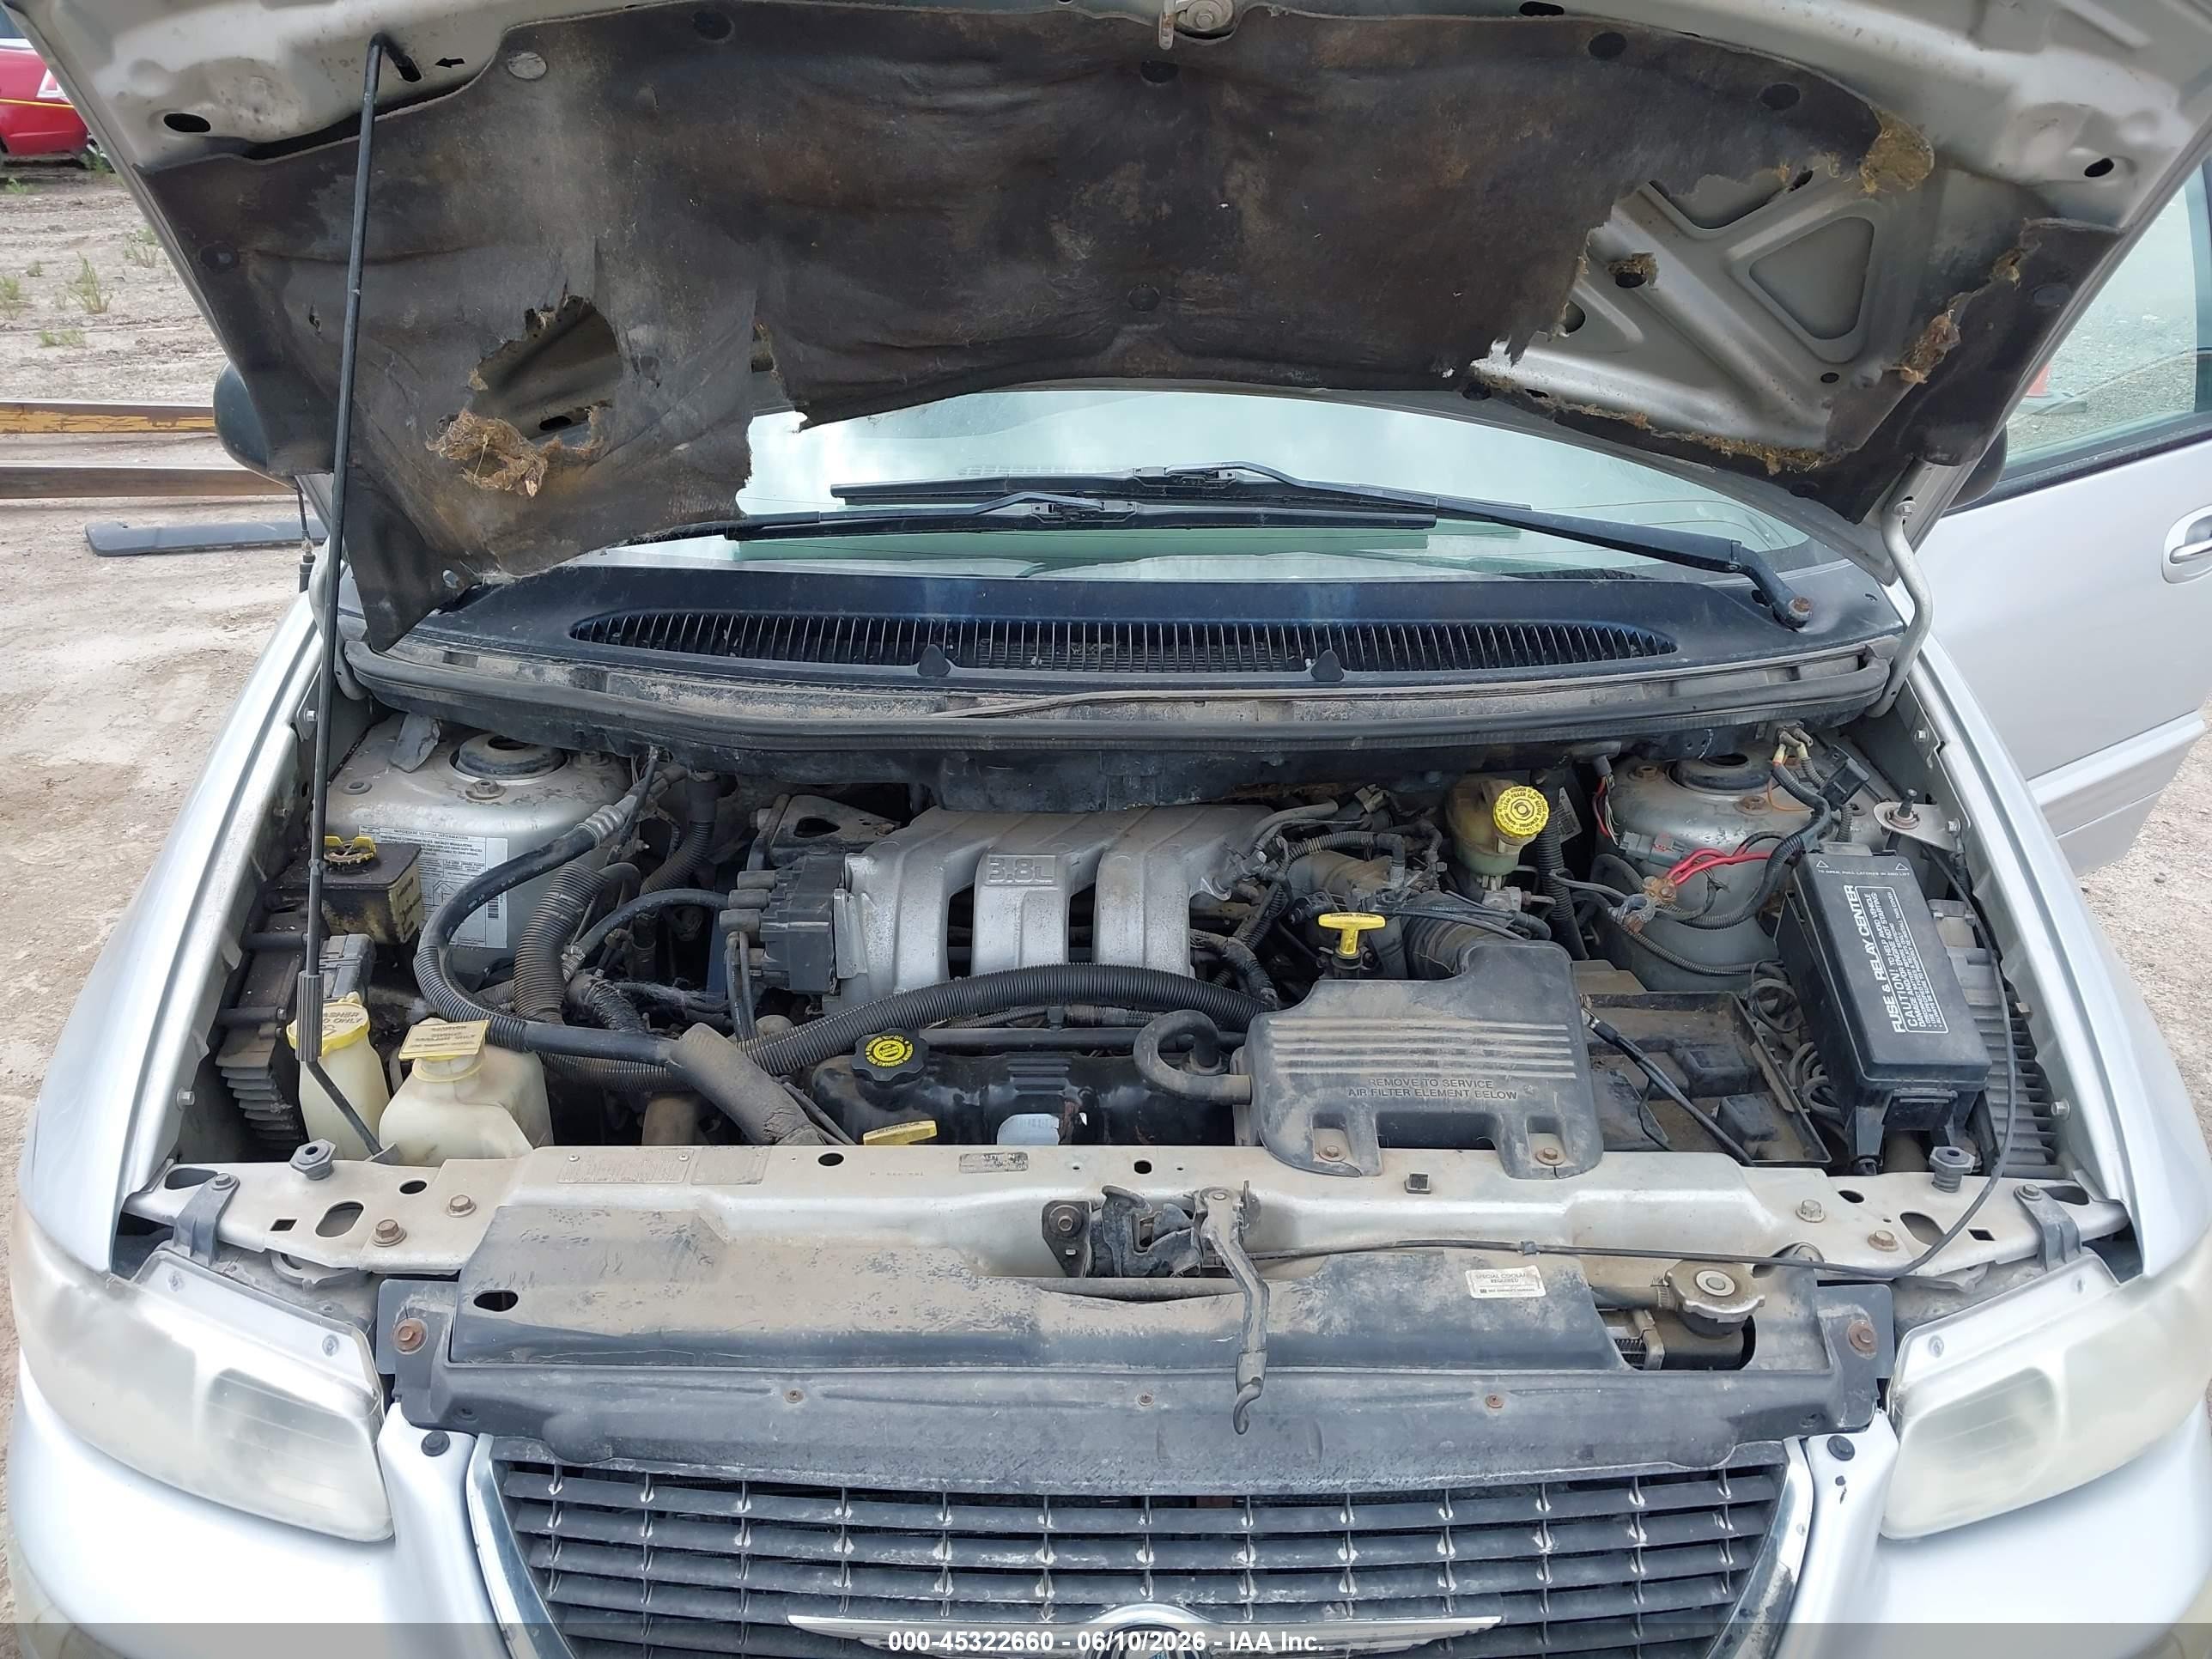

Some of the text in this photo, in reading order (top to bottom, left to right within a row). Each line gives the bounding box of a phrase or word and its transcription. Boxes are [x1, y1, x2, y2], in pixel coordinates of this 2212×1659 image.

[989, 858, 1054, 884] 3.8L
[1844, 884, 1906, 1032] FUSE & RELAY CENTER
[1864, 892, 1918, 1026] CAUTION! TO HELP AVOID VEHICLE
[1871, 891, 1926, 1027] DAMAGE AND/OR ENGINE NOT STARTING
[1906, 968, 1918, 990] BATTERY
[334, 1017, 364, 1025] ONLY
[1348, 1088, 1518, 1100] AIR FILTER ELEMENT BELOW
[1370, 1078, 1493, 1089] REMOVE TO SERVICE
